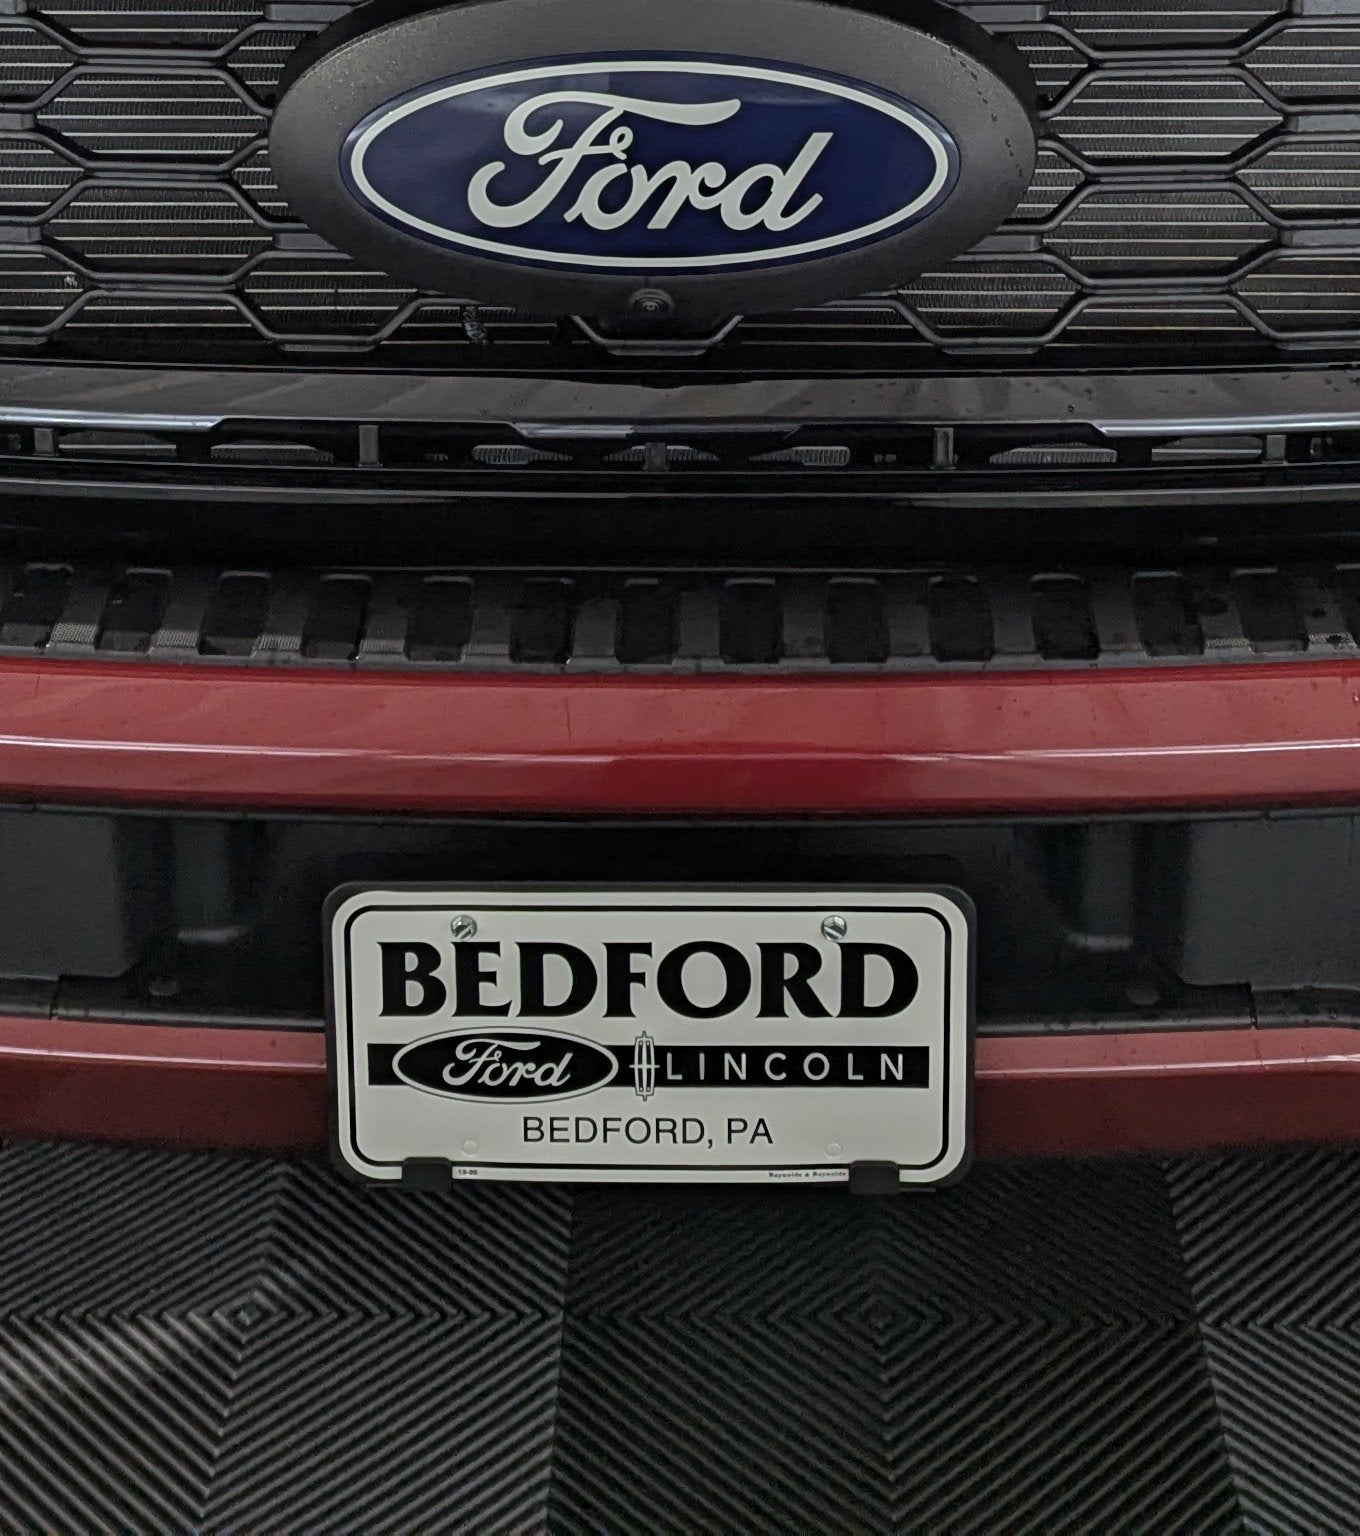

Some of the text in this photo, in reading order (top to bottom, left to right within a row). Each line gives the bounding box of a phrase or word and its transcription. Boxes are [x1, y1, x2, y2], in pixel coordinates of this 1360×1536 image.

[466, 89, 834, 232] Ford
[377, 940, 919, 1020] BEDFORD
[441, 1038, 572, 1086] Ford
[665, 1053, 904, 1081] LINCOLN
[522, 1116, 774, 1148] BEDFORD, PA
